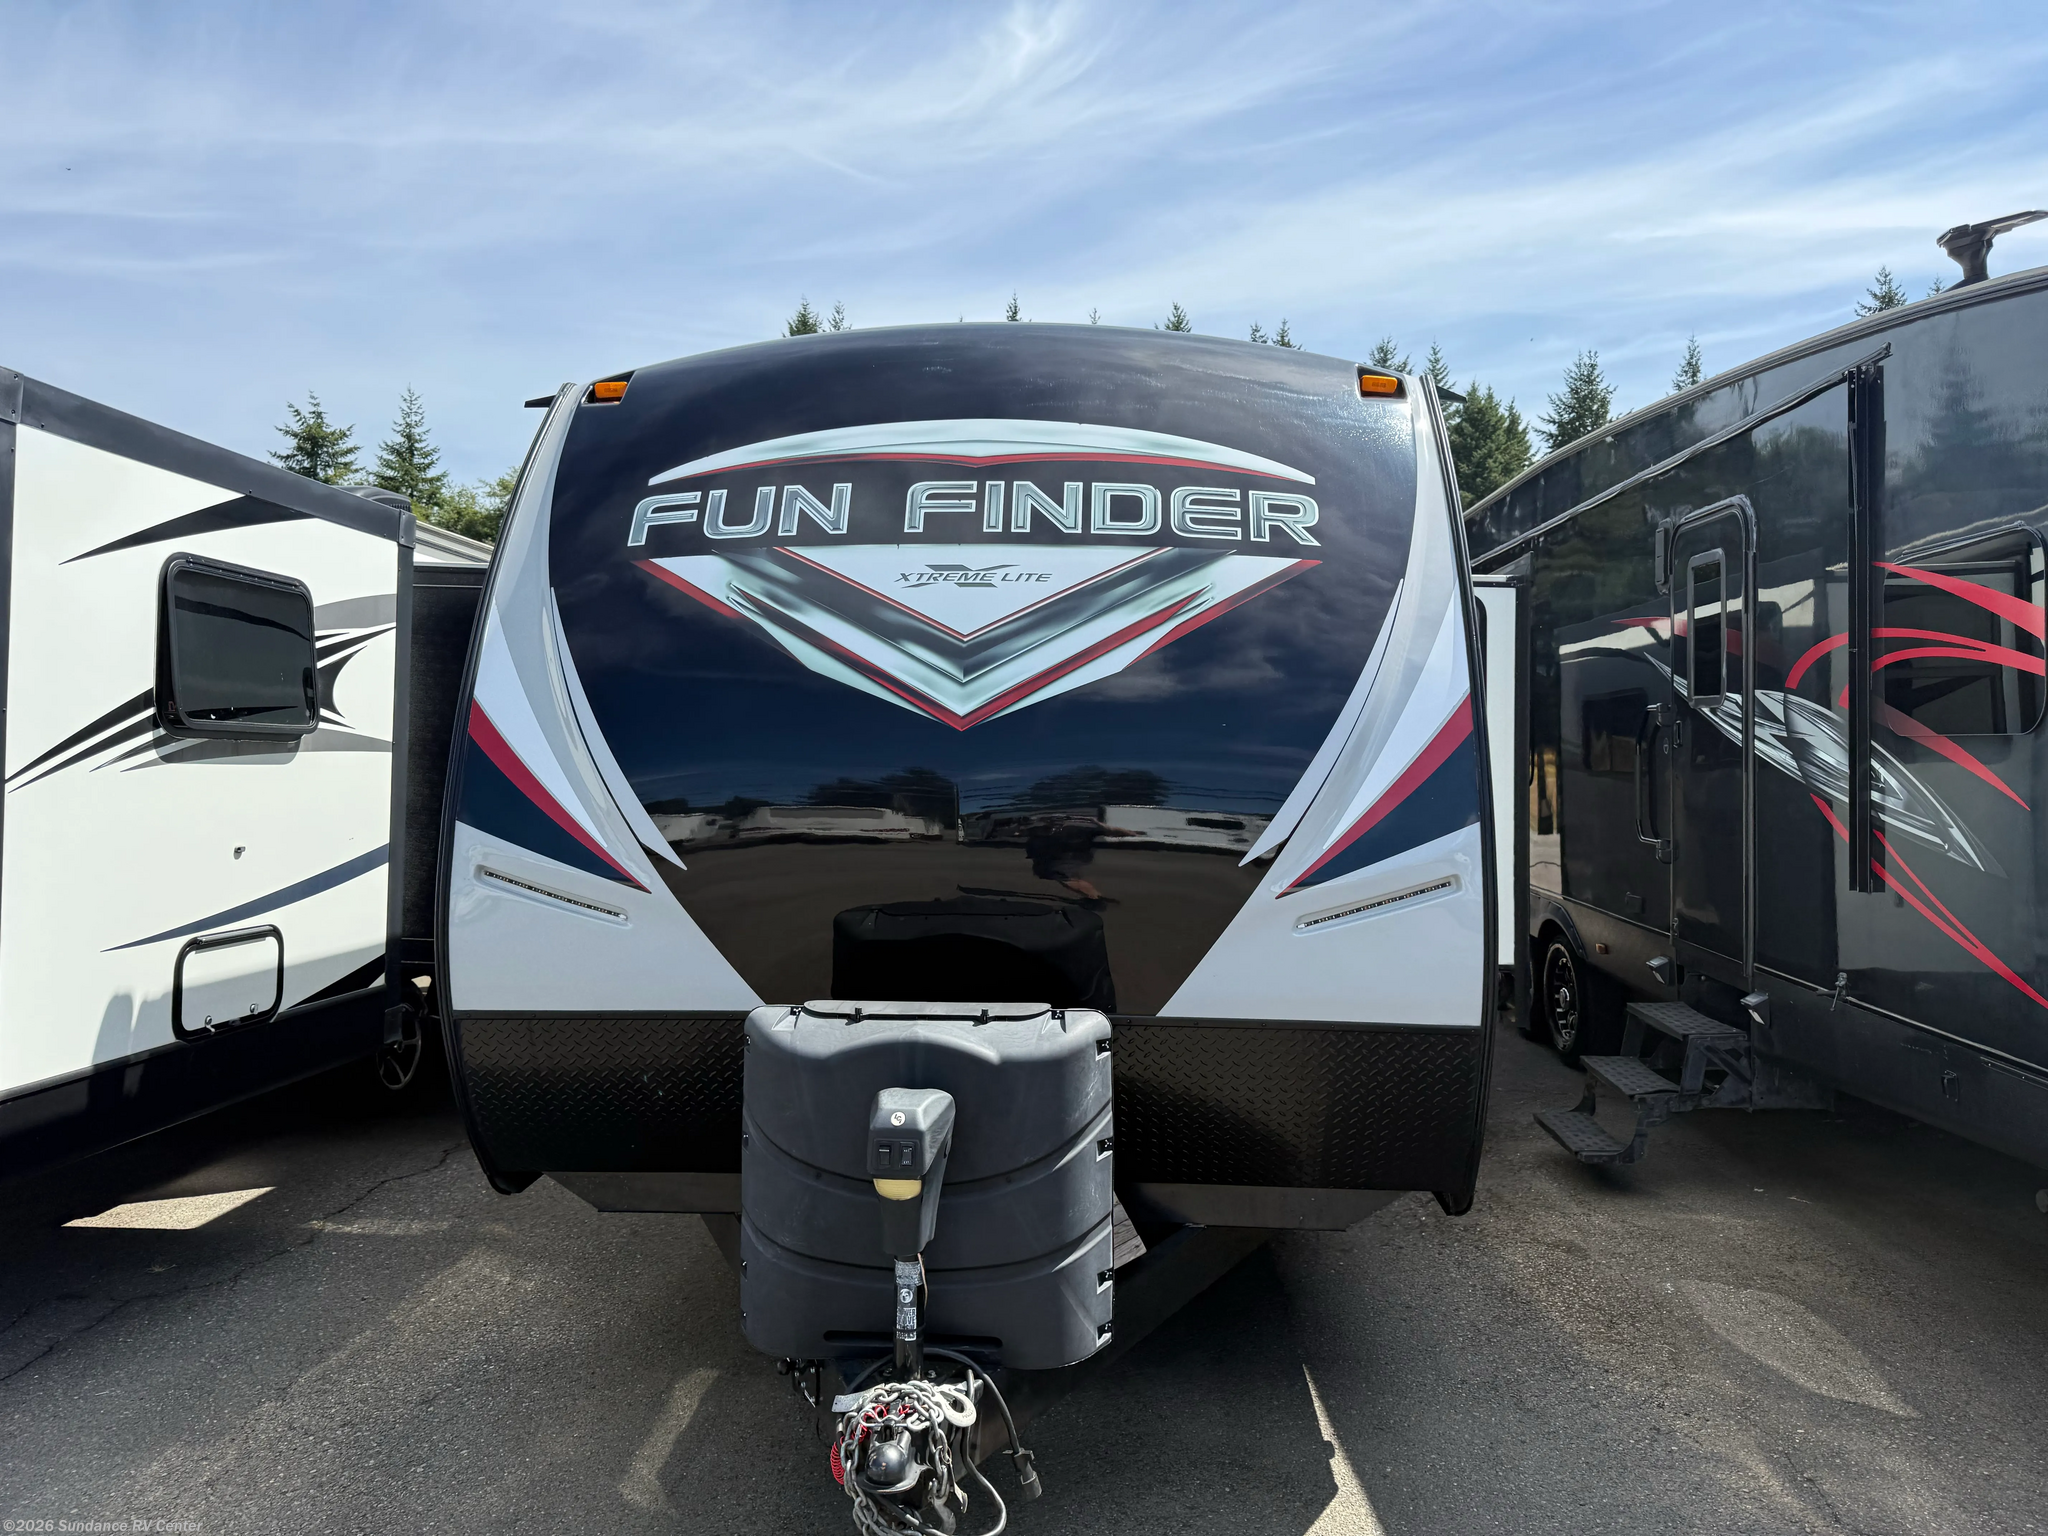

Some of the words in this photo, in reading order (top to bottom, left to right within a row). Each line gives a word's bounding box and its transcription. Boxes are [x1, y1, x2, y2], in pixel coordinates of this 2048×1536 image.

[627, 483, 852, 547] FUN
[904, 480, 1321, 547] FINDER
[894, 572, 998, 583] XTREME
[1001, 572, 1052, 583] LITE
